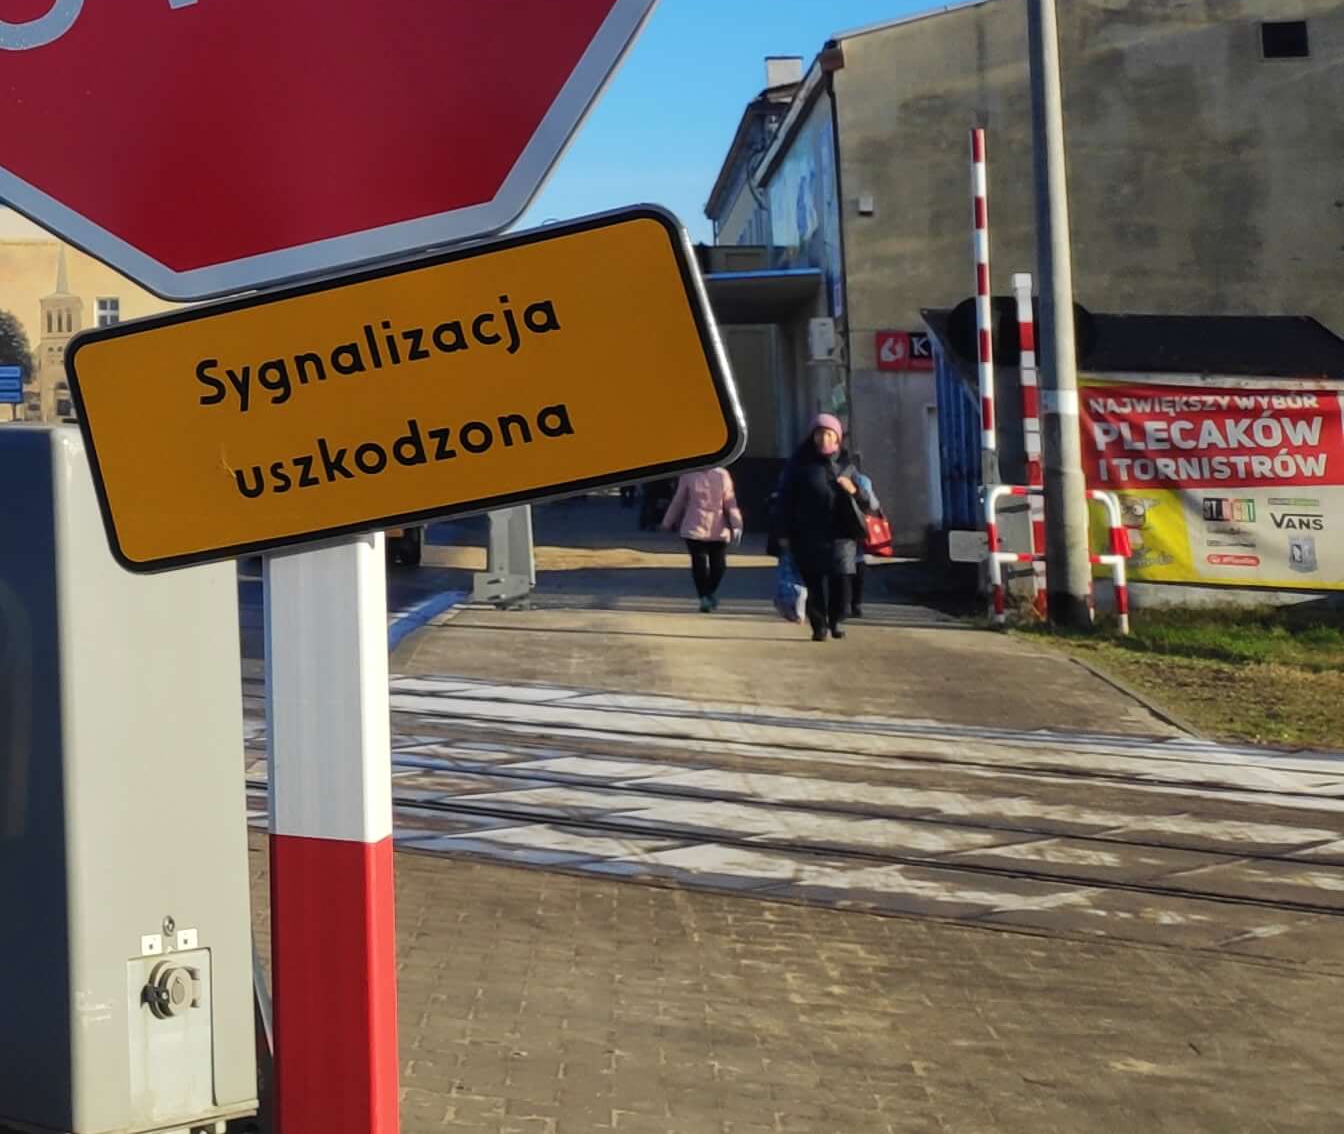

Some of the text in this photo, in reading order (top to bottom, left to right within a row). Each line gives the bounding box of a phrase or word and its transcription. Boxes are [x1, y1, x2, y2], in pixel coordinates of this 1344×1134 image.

[196, 295, 561, 411] Sygnalizacja
[1088, 392, 1320, 416] NAJWIĘKSZY WYBÓR
[1093, 409, 1323, 452] PLECAKÓW
[235, 404, 574, 498] uszkodzona
[1098, 448, 1328, 482] I TORNISTRÓW
[1270, 513, 1324, 530] VANS
